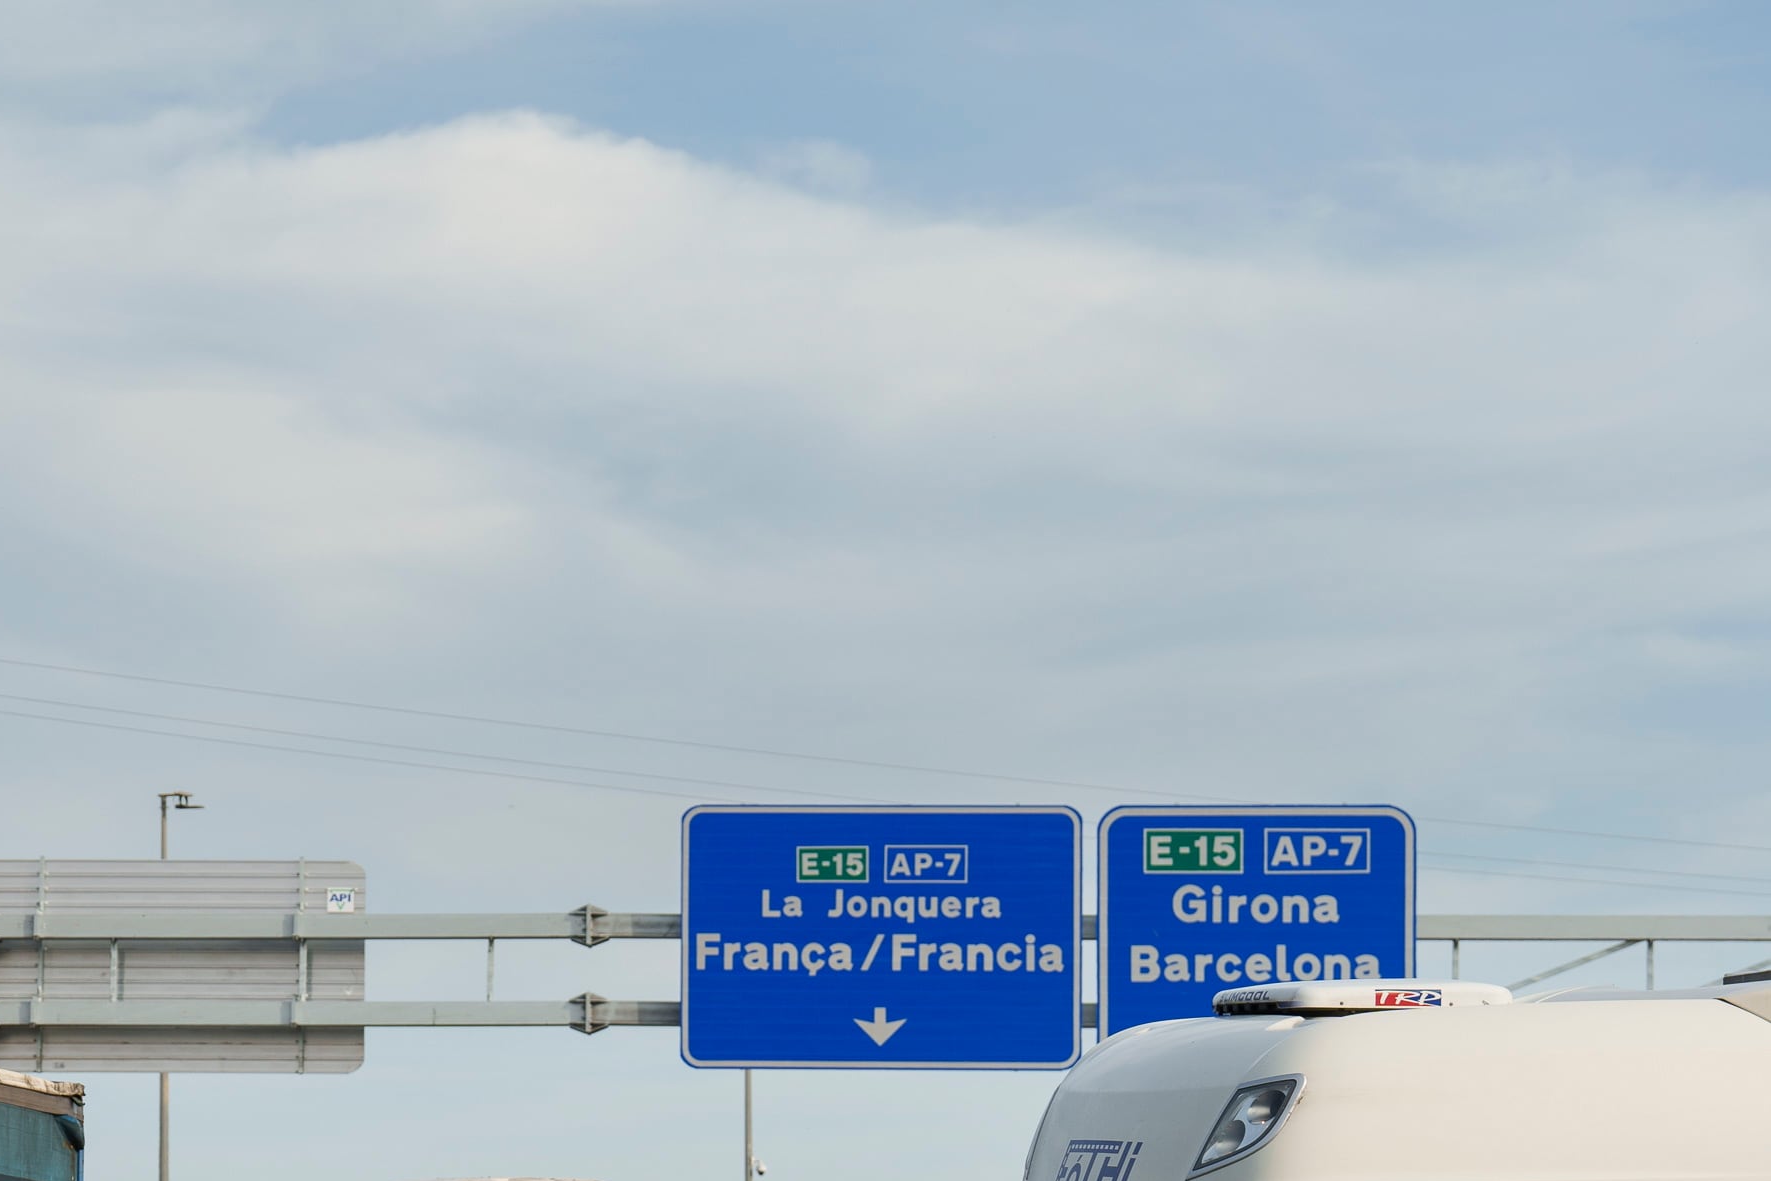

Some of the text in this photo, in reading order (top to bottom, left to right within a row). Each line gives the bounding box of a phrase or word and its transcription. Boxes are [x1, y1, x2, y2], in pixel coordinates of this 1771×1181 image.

[800, 853, 961, 876] E-15 AP-7
[1149, 835, 1363, 867] E-15 AP-7
[761, 888, 1002, 923] La Jonquera
[1172, 883, 1340, 924] Girona
[1130, 944, 1381, 982] Barcelona
